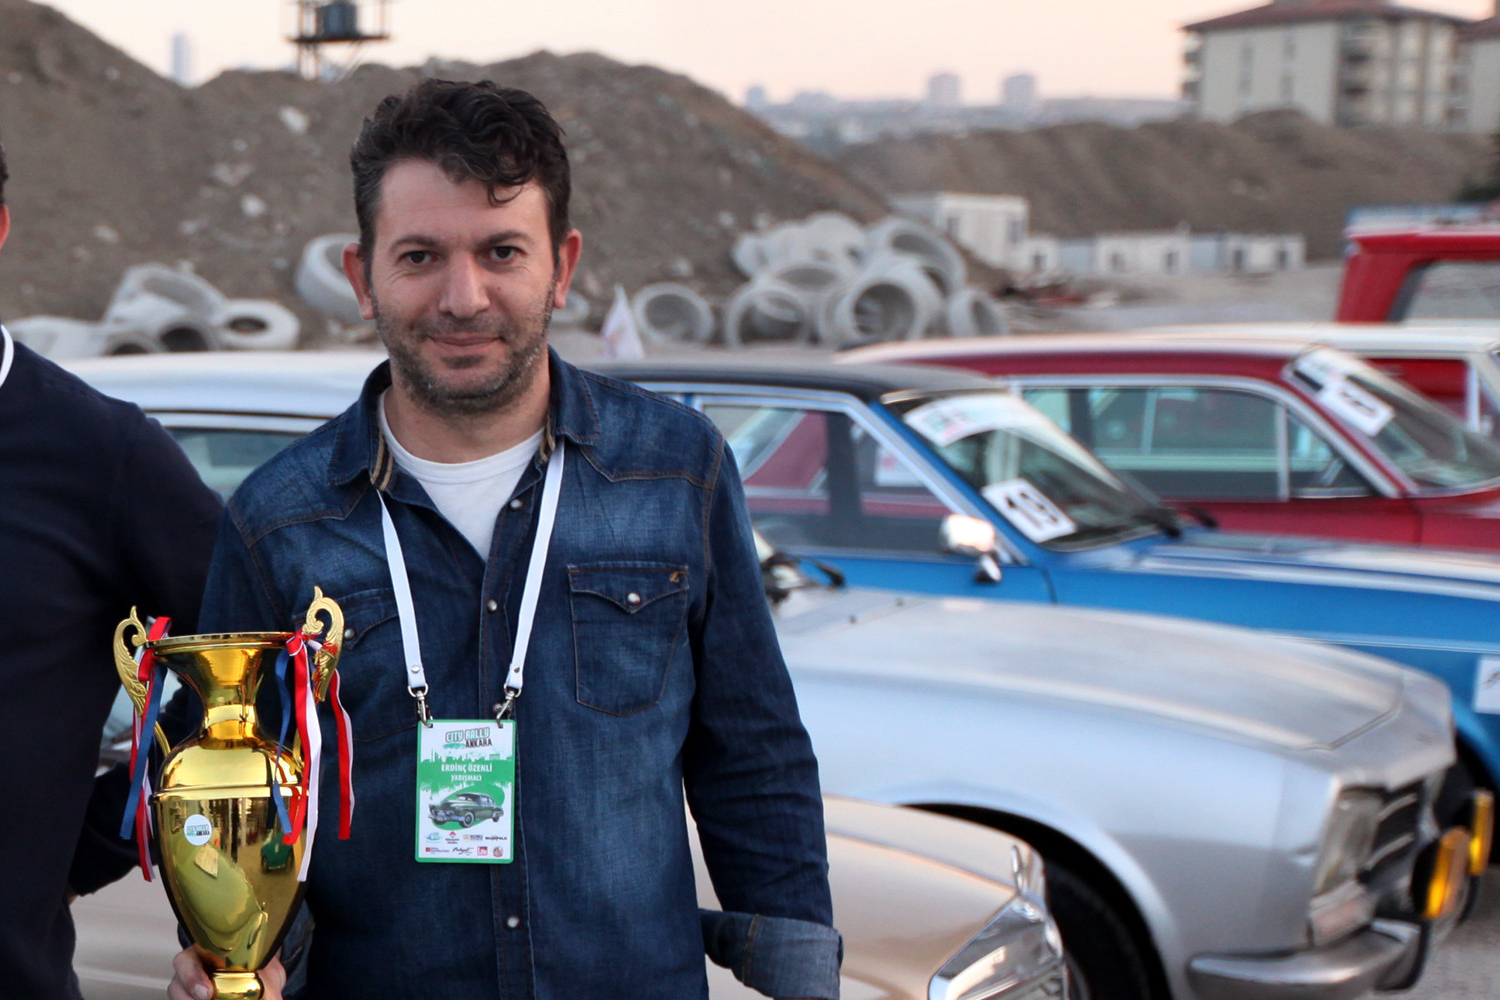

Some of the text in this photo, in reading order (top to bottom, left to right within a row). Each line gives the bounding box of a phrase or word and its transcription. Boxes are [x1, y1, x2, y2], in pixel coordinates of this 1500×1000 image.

[445, 727, 490, 743] CITY RALLY
[465, 739, 492, 748] ANKARA
[441, 762, 493, 773] ERDİNÇ ÖZENLİ
